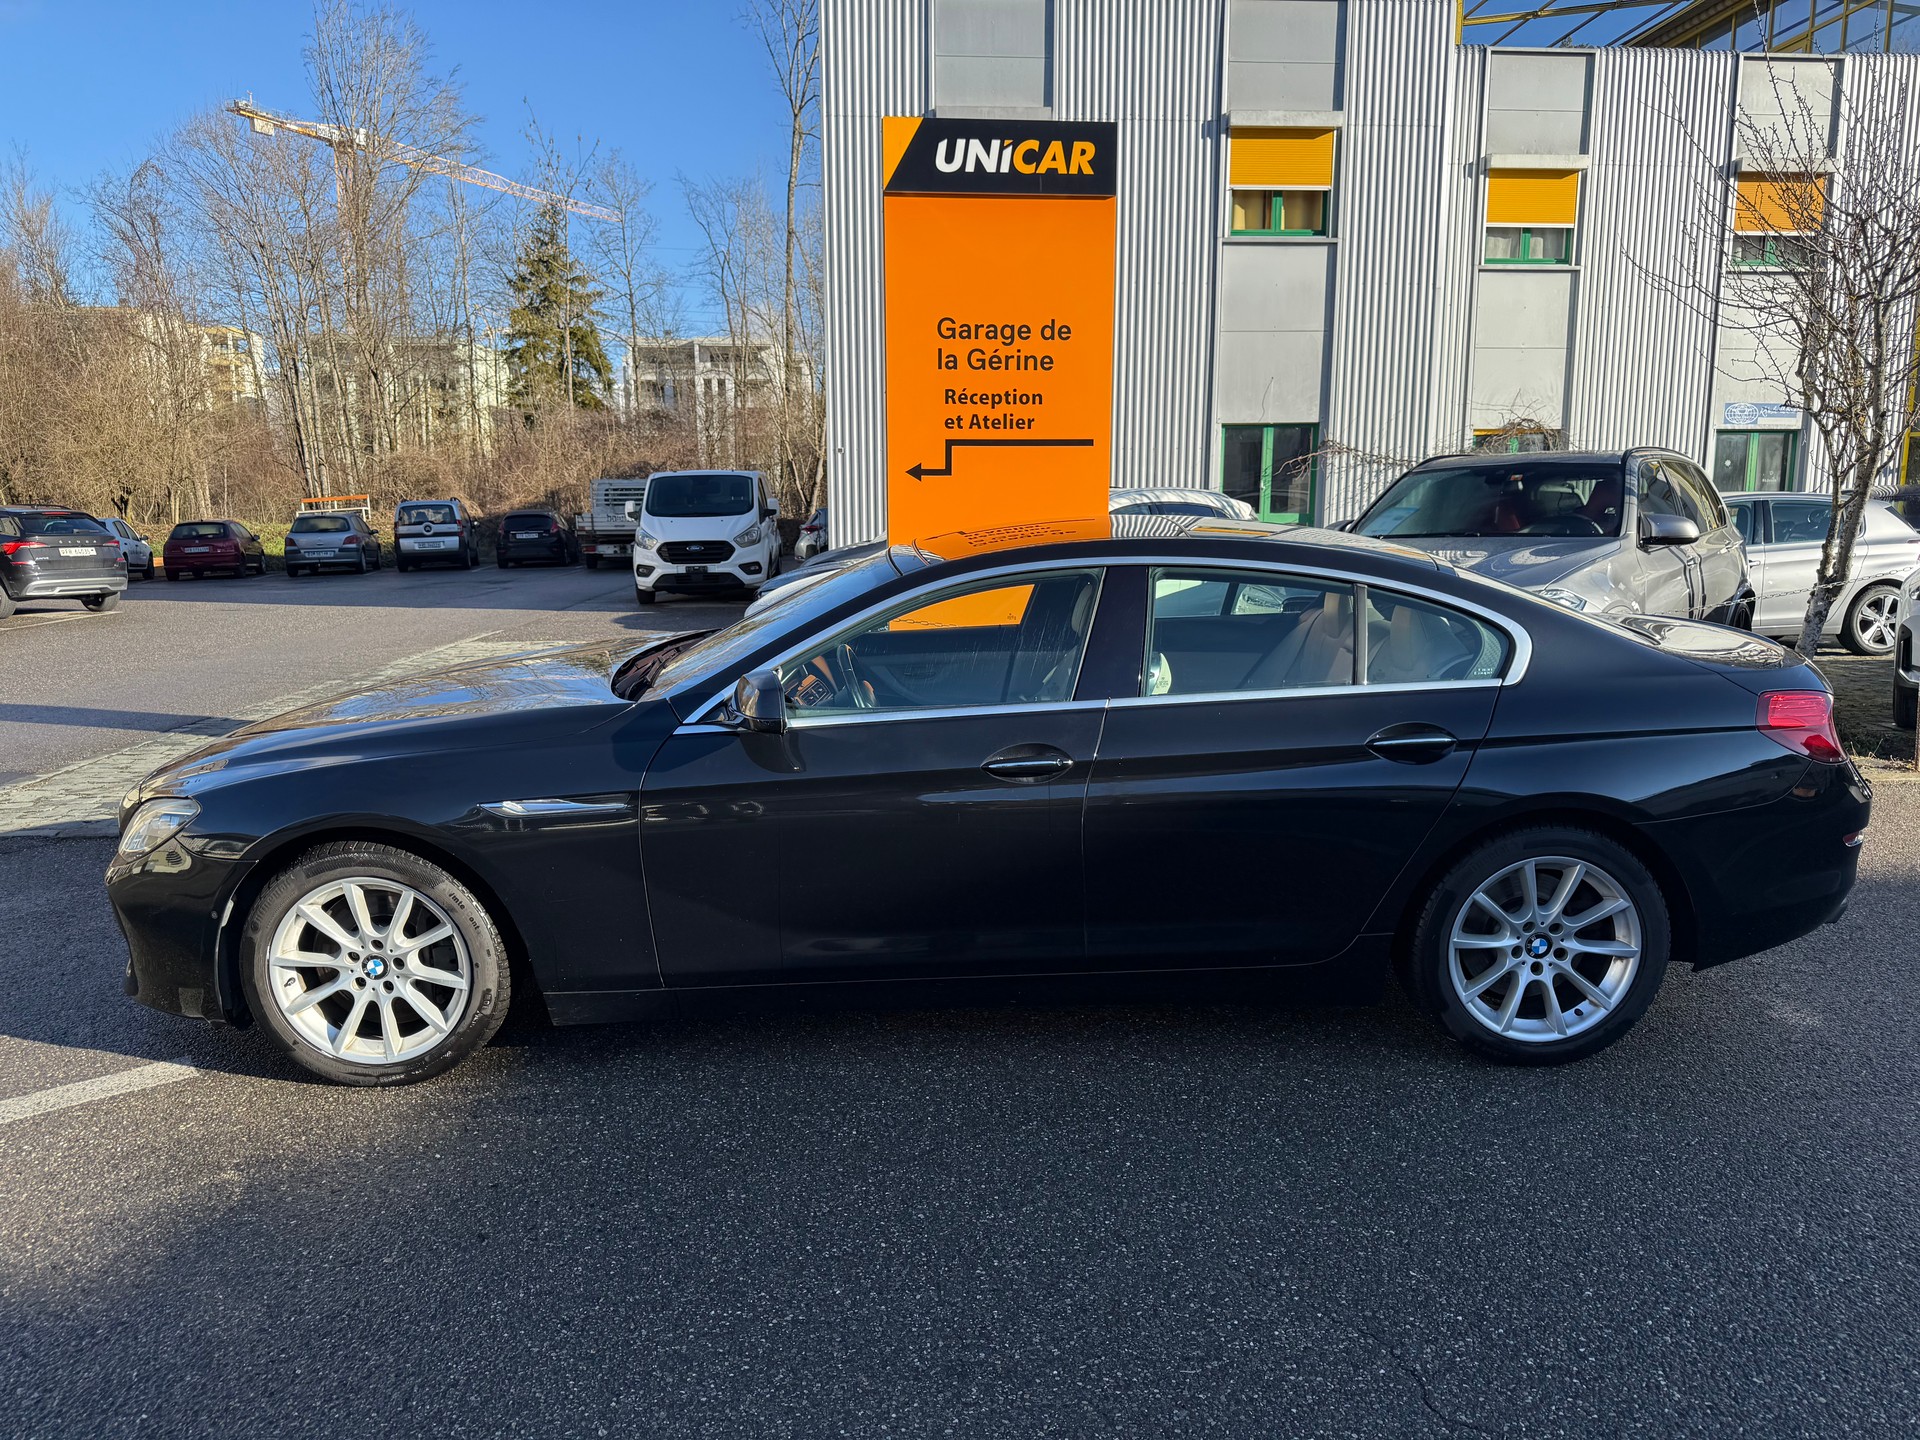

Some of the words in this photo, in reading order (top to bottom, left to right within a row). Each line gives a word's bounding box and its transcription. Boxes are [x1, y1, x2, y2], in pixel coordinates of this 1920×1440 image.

[938, 317, 1031, 346] Garage
[1041, 319, 1071, 340] de
[938, 348, 957, 370] la
[967, 349, 1053, 370] Gérine
[945, 388, 1042, 409] Réception
[945, 416, 963, 429] et
[969, 414, 1034, 429] Atelier
